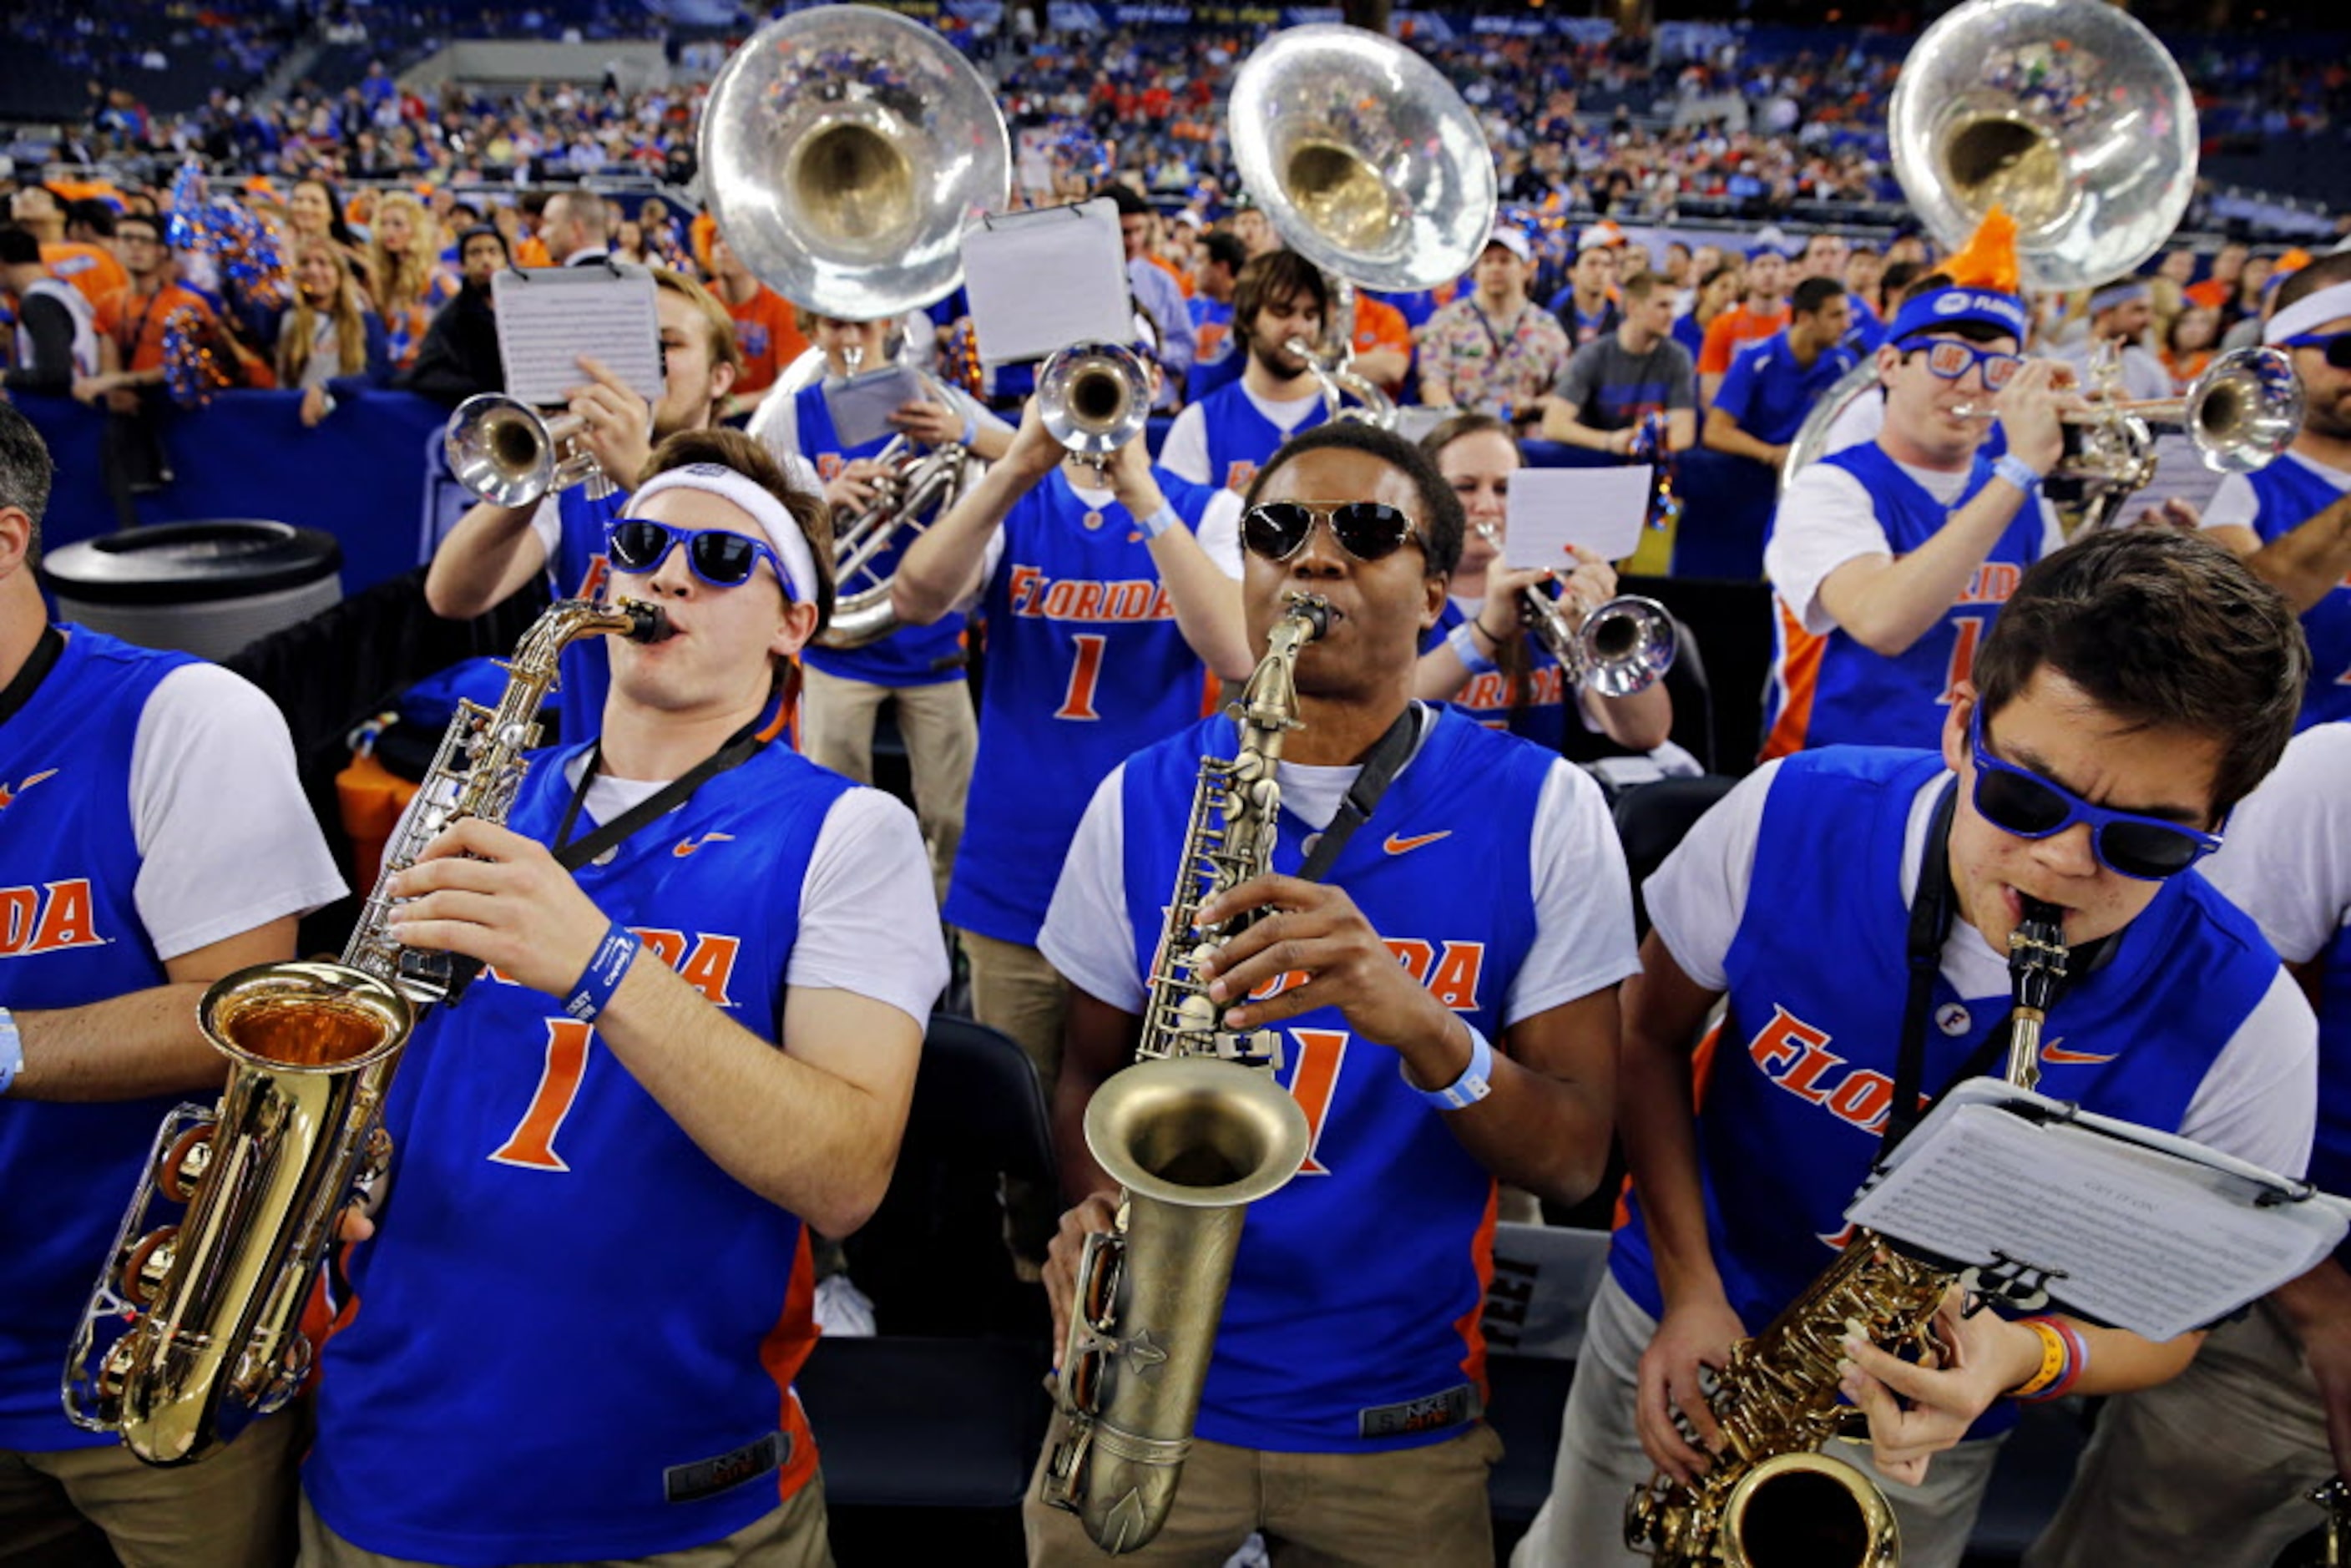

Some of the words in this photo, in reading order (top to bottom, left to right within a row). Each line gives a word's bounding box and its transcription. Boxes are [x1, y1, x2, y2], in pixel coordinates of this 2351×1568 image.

[1009, 563, 1177, 623] FLORIDA
[1053, 632, 1107, 722] 1
[486, 1015, 594, 1173] 1
[1287, 1027, 1350, 1176] 1
[1747, 1001, 1896, 1137] FLO
